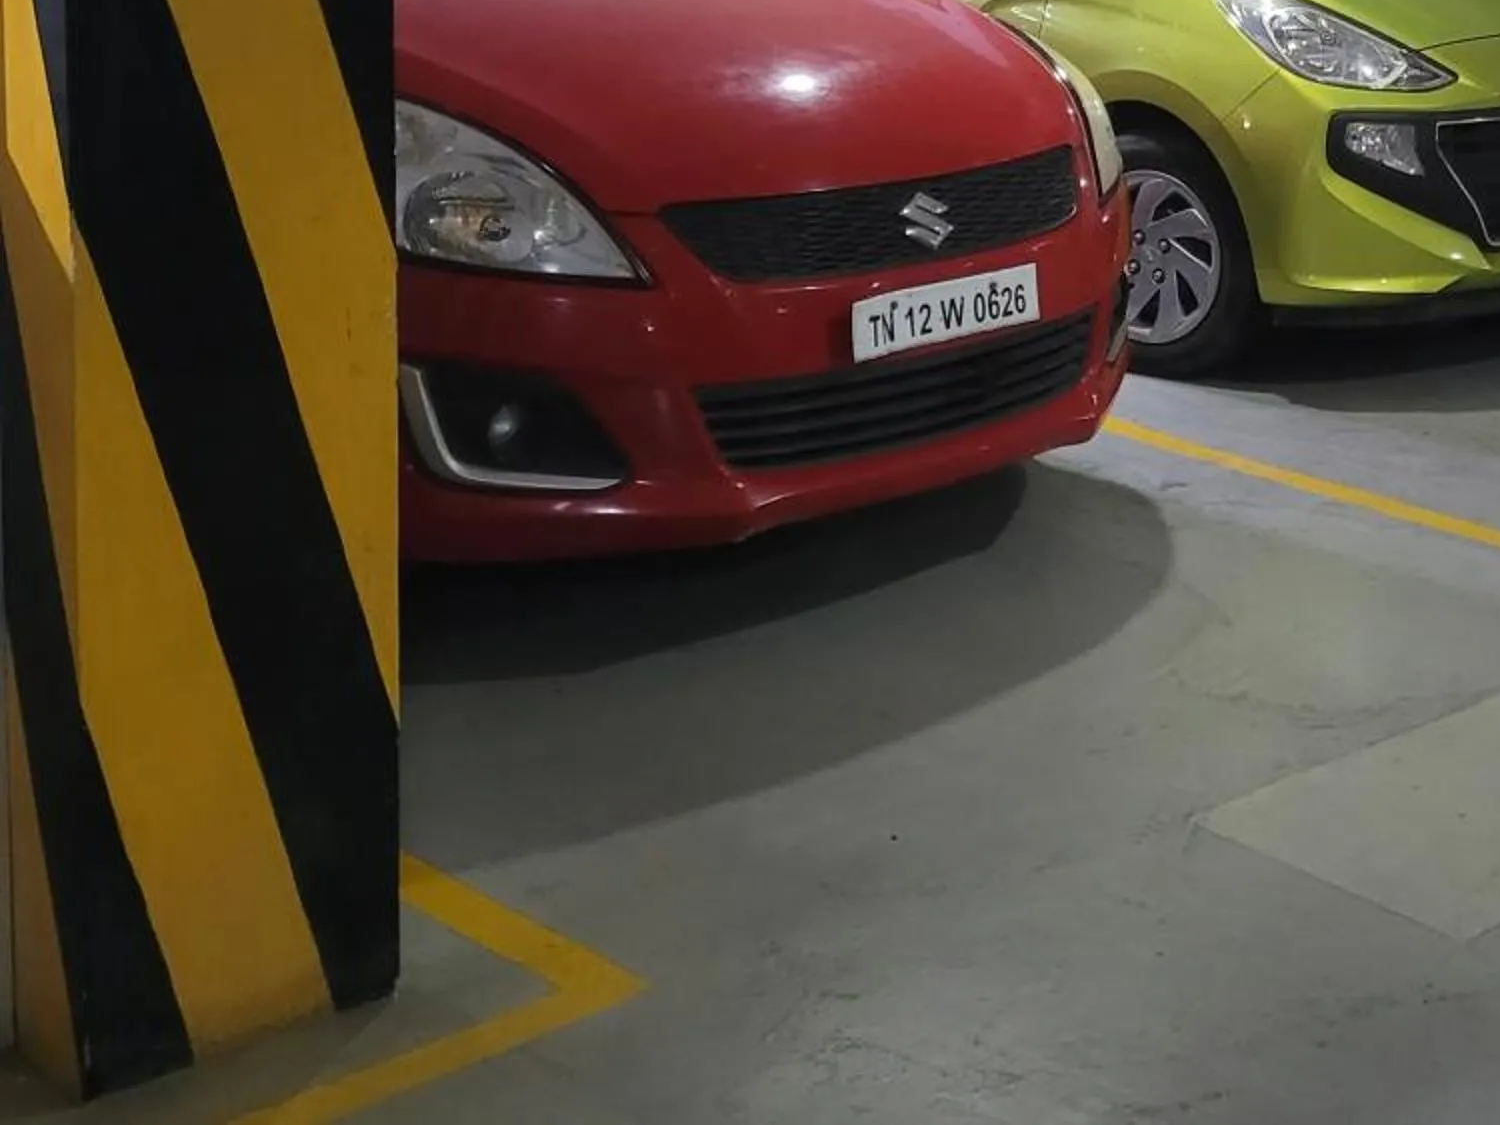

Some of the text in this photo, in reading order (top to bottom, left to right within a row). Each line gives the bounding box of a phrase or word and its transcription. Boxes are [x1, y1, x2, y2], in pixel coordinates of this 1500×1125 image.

[868, 283, 1026, 348] TN 12 W 0626
